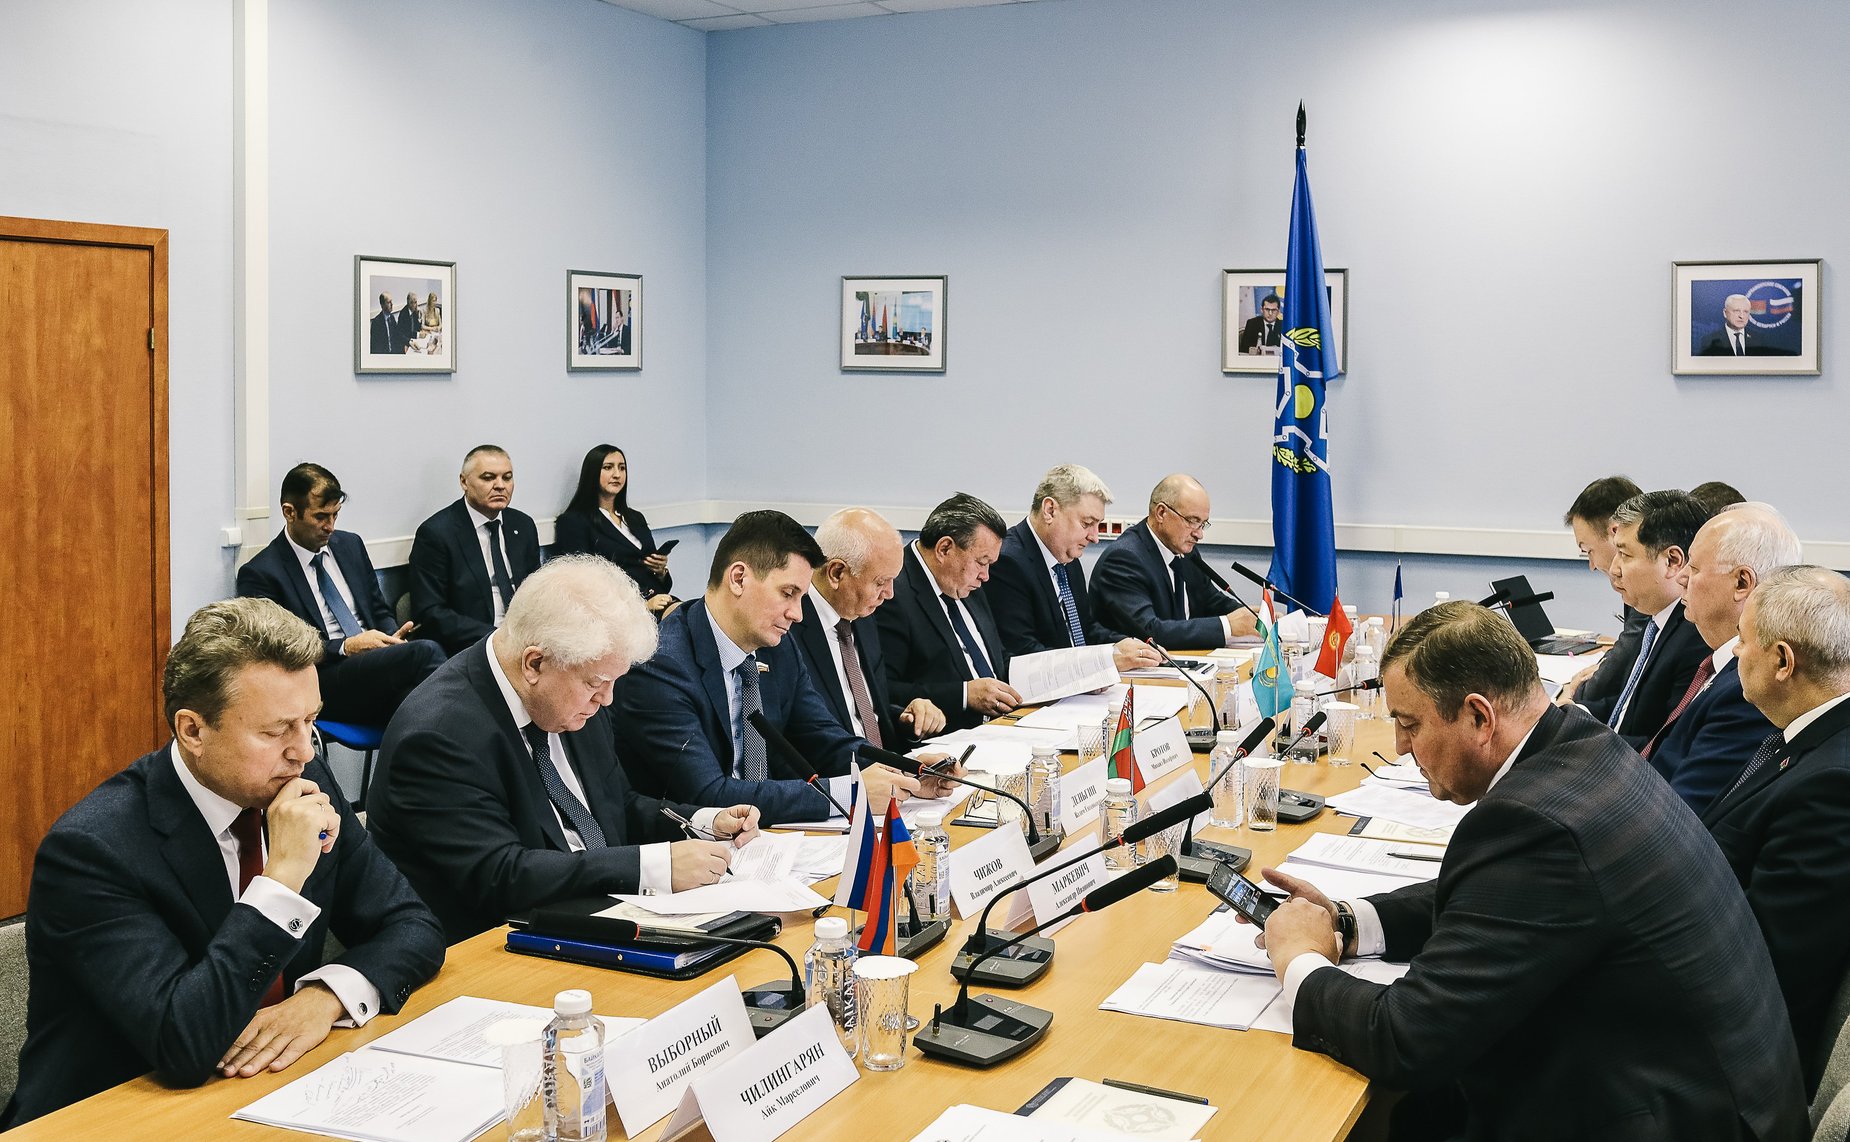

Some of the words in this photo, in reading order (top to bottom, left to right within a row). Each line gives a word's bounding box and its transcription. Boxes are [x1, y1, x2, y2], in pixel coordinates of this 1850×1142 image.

[1150, 742, 1171, 759] КРОТОВ
[969, 883, 994, 901] Владимир
[993, 870, 1018, 888] Алексеевич
[973, 858, 1003, 881] ЧИЖОВ
[1051, 862, 1091, 895] МАРКЕВИЧ
[1055, 891, 1078, 910] Александр
[1076, 878, 1097, 897] Иванович
[647, 1014, 723, 1074] ВЫБОРНЫЙ
[656, 1062, 692, 1093] Анатолий
[691, 1039, 730, 1070] Борисович
[739, 1041, 825, 1106] ЧИЛИНГАРЯН
[760, 1102, 778, 1120] Айк
[778, 1074, 821, 1110] Марселович
